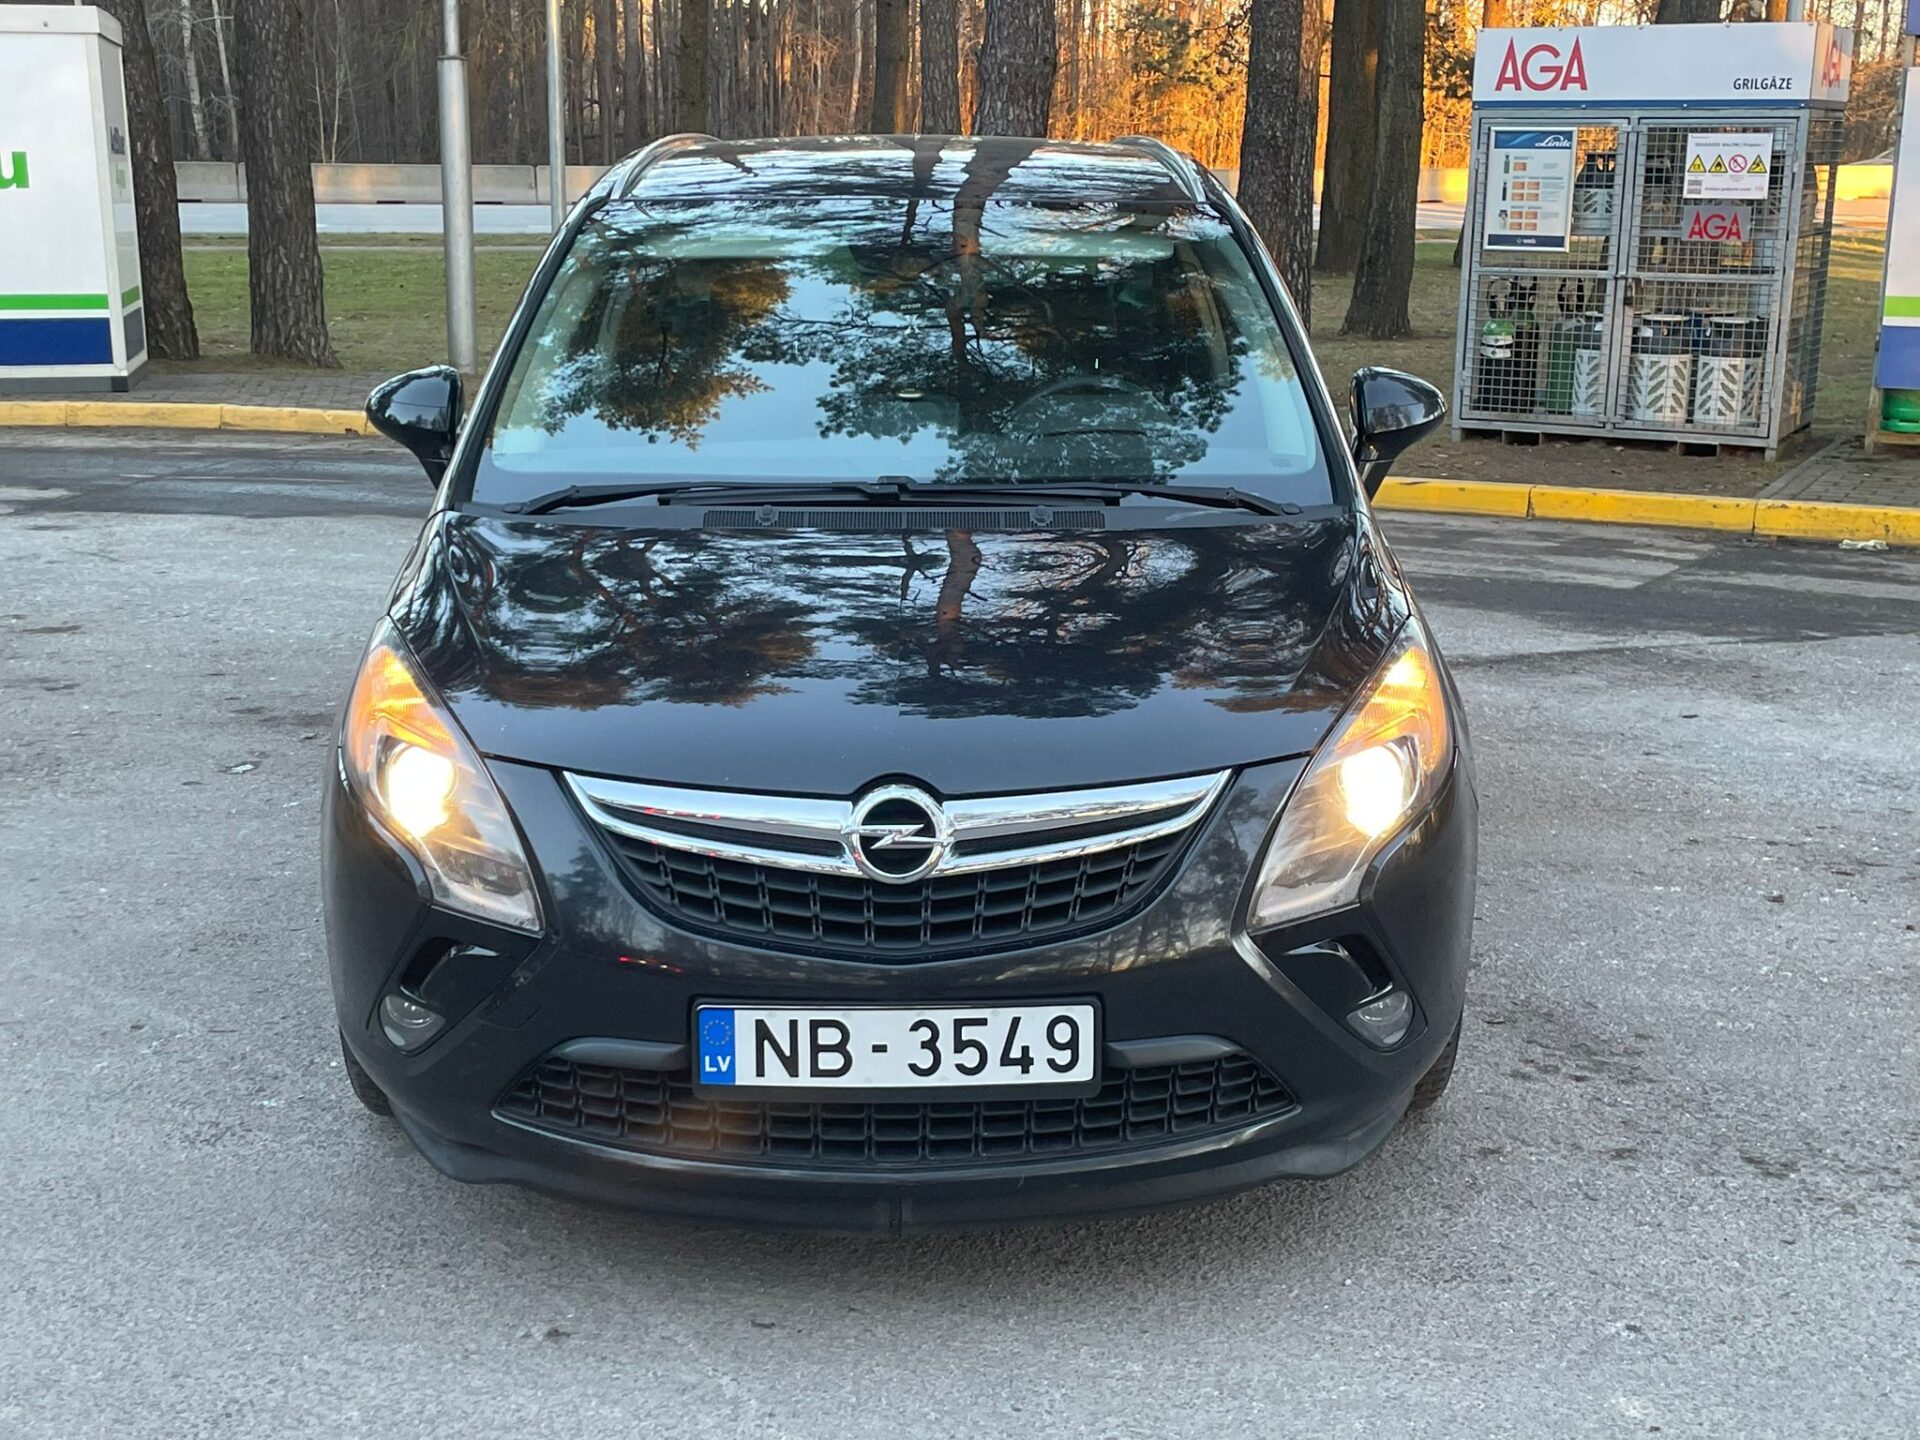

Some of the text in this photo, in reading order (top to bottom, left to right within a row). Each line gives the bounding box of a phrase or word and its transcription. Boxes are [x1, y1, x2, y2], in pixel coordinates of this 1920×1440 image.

[1494, 35, 1588, 91] AGA
[1733, 76, 1793, 90] GRILGĀZE
[1687, 210, 1742, 240] AGA
[704, 1055, 732, 1073] LV
